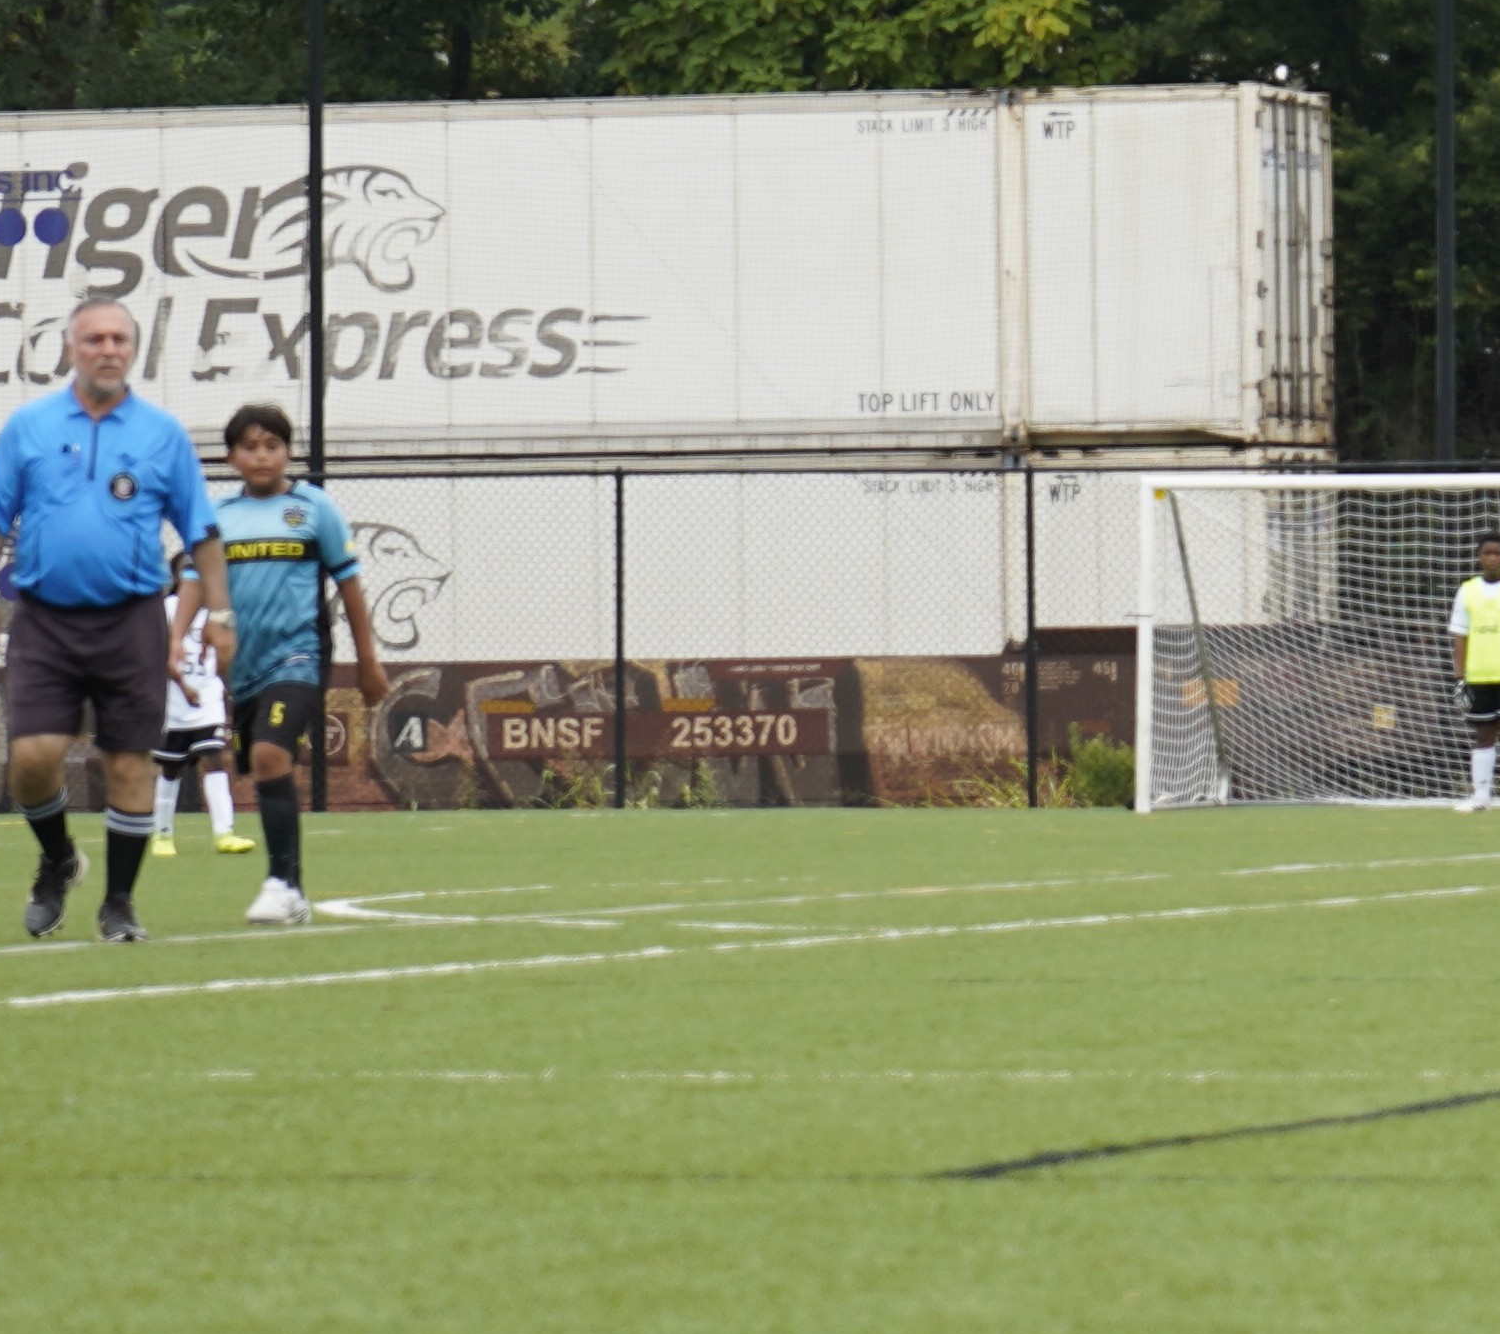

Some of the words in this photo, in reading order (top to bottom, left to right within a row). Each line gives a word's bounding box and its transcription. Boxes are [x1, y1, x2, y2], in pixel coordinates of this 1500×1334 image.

[857, 118, 894, 134] STACK
[901, 117, 934, 133] LIMIT
[957, 117, 987, 132] HIGH
[1041, 120, 1076, 140] WTP
[192, 297, 583, 381] Express
[857, 393, 894, 413] TOP
[901, 392, 941, 412] LIFT
[949, 391, 996, 412] ONLY
[1049, 482, 1082, 504] WTP
[503, 716, 605, 749] BNSF
[671, 715, 799, 749] 253370
